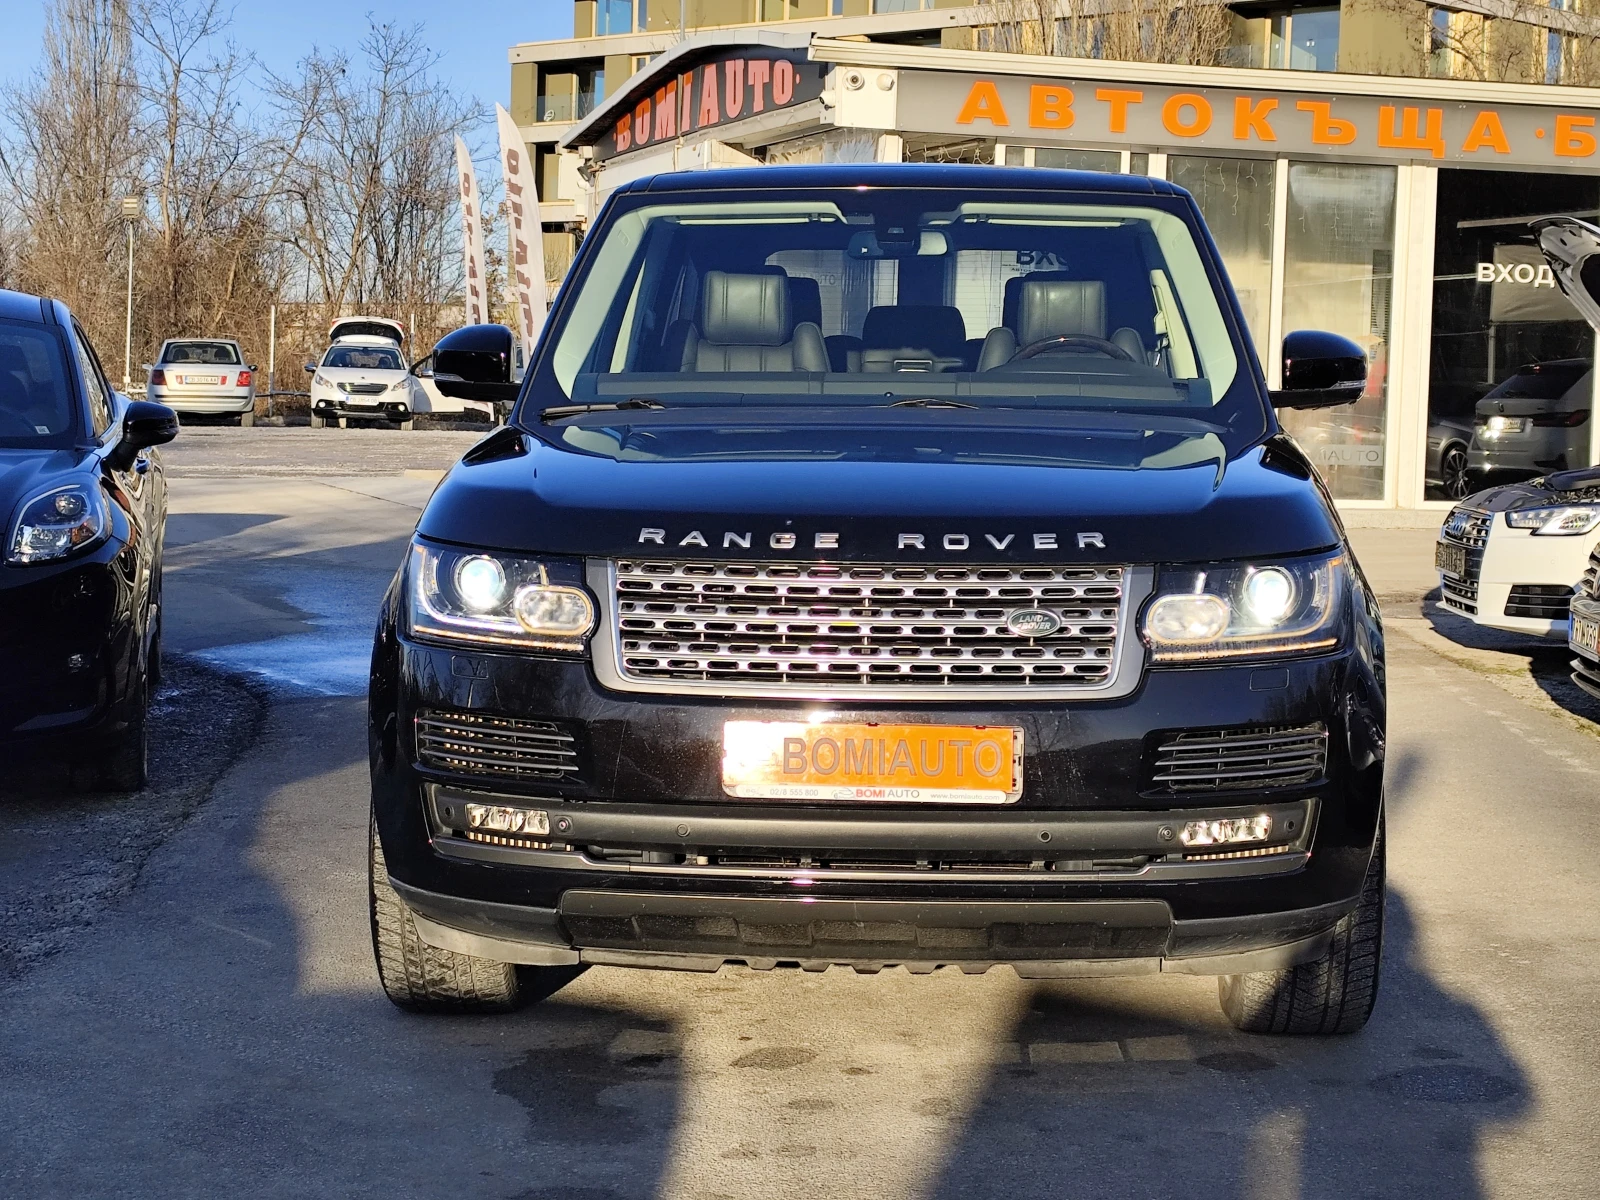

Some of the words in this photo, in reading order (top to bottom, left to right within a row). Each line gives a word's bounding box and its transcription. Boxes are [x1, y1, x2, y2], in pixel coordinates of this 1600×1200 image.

[956, 80, 1512, 159] АВТОКЪЩА
[1477, 262, 1555, 288] ВХОД
[638, 527, 840, 549] RANGE
[897, 531, 1106, 550] ROVER
[1018, 614, 1044, 623] LAND
[1020, 621, 1051, 630] ROVER
[783, 737, 1004, 777] BOMIAUTO
[769, 788, 788, 796] 02/8
[789, 788, 804, 796] 555
[804, 789, 819, 797] 800
[855, 788, 886, 798] BOMI
[886, 789, 920, 799] AUTO
